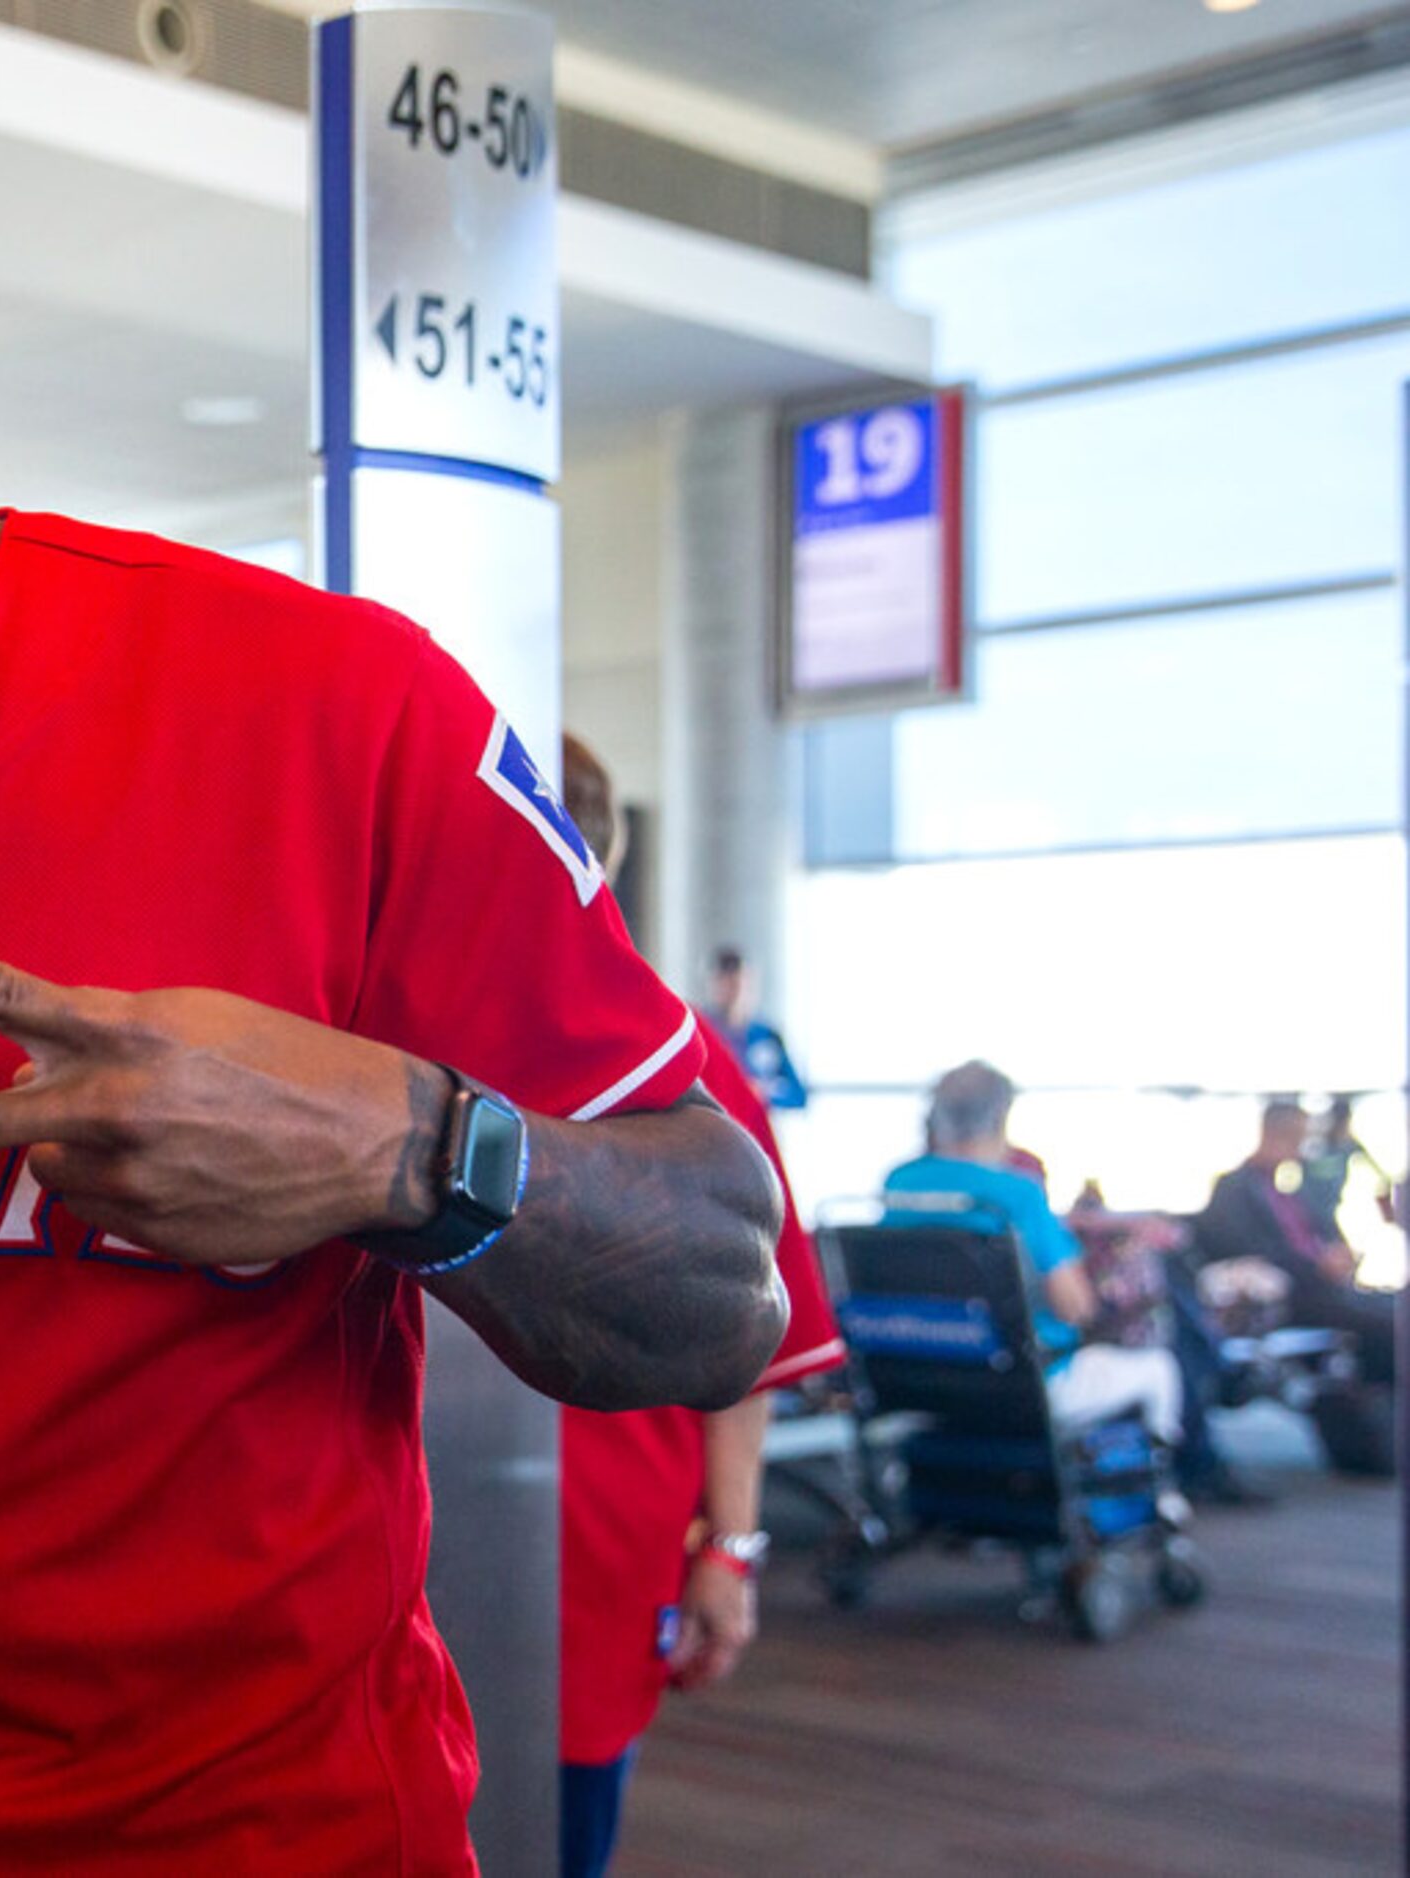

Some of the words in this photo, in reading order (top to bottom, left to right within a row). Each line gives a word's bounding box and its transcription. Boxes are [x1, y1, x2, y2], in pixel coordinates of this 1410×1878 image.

[388, 64, 531, 180] 46-50
[415, 293, 547, 408] 51-55
[813, 406, 924, 507] 19
